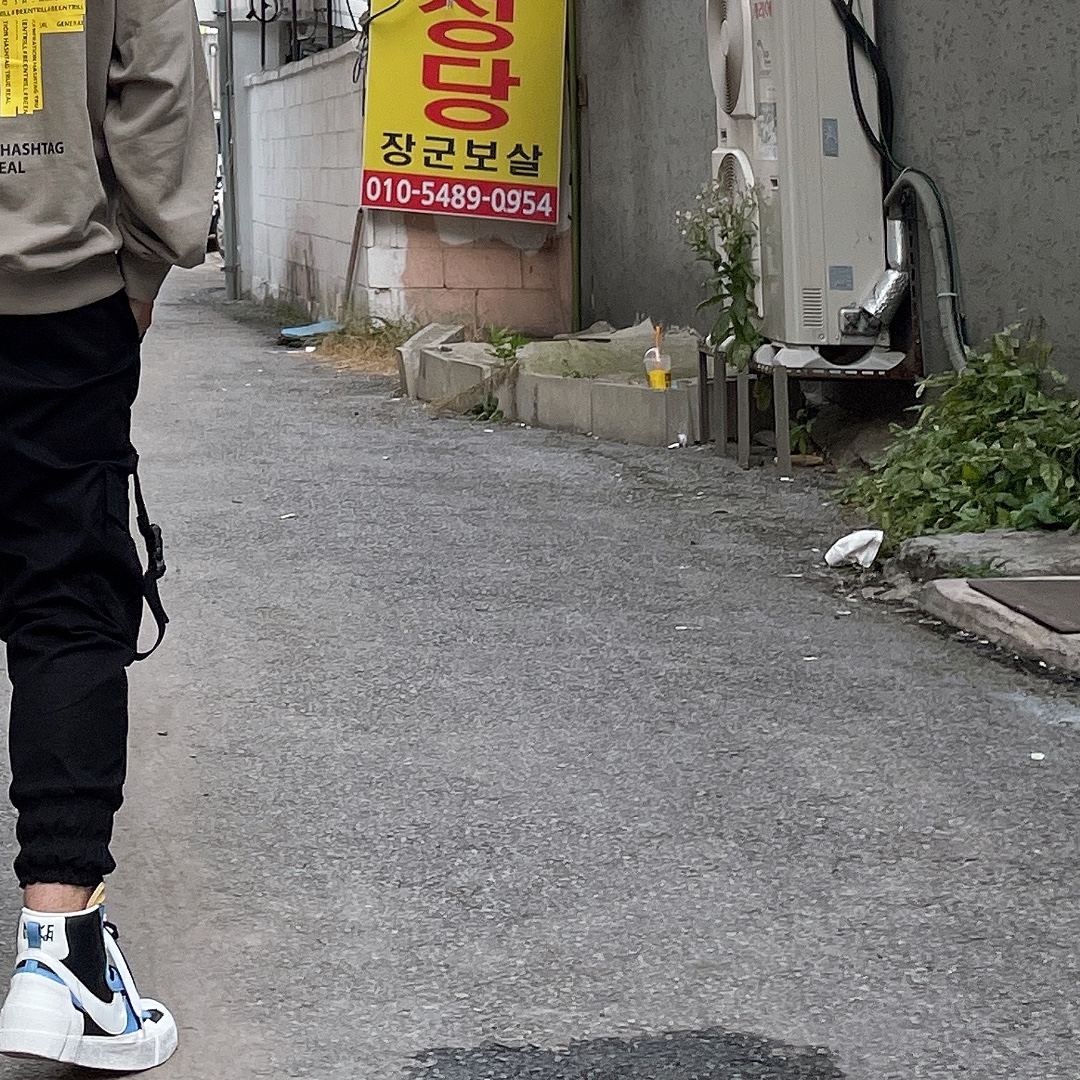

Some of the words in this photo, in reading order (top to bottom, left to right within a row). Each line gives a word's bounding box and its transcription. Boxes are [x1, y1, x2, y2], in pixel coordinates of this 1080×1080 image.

[0, 141, 65, 157] HASHTAG
[380, 131, 544, 178] 장군보살
[365, 176, 554, 217] 010-5489-0954
